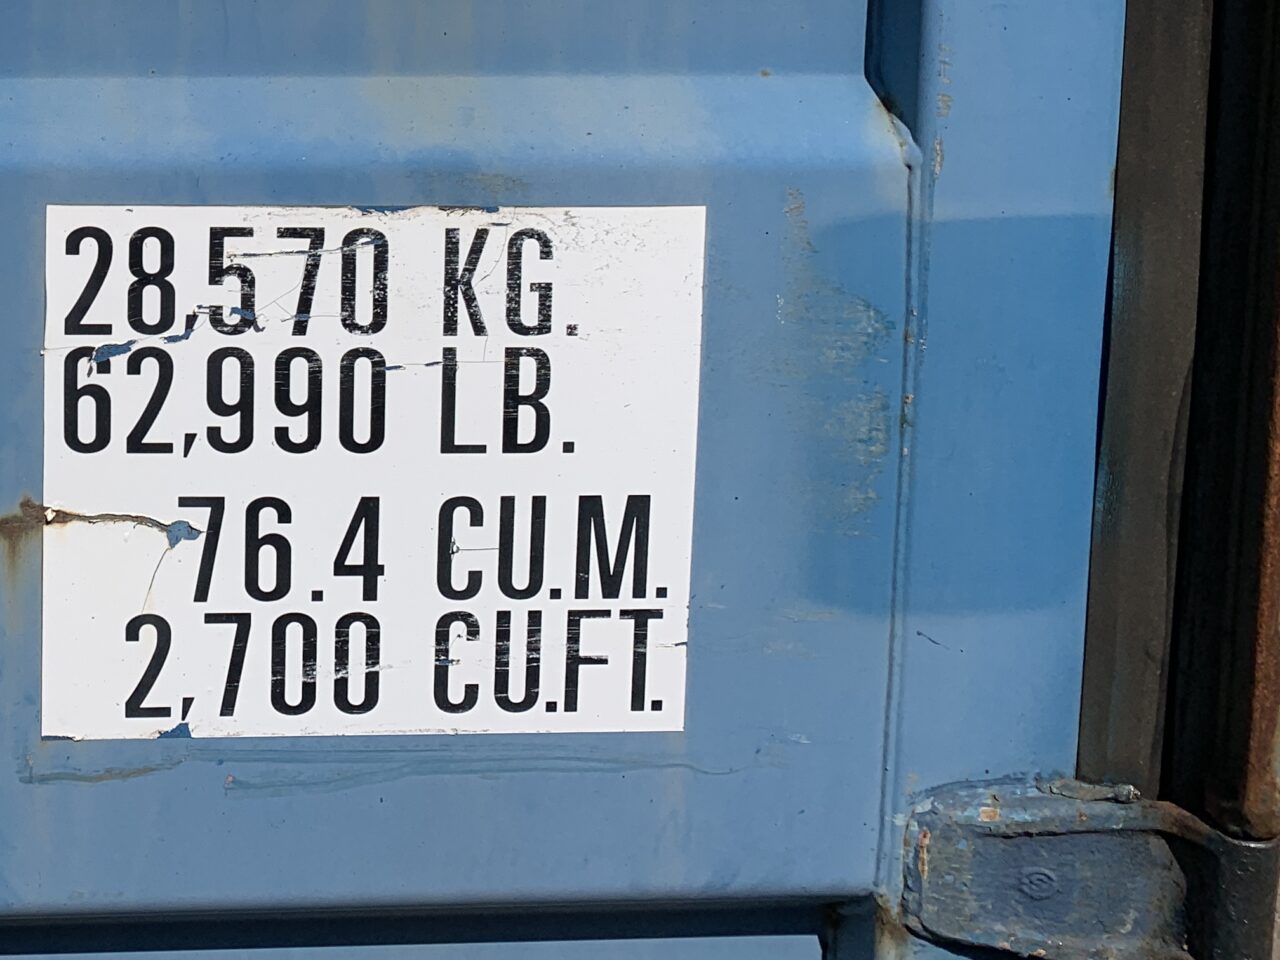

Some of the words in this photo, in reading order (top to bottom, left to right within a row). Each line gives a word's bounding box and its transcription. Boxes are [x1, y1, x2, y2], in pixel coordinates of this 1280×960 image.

[64, 226, 389, 342] 28,570
[442, 227, 579, 337] KG.
[63, 346, 387, 458] 62,990
[440, 346, 576, 455] LB.
[177, 495, 385, 602] 76.4
[436, 495, 668, 600] CU.M.
[124, 611, 381, 721] 2,700
[432, 608, 664, 713] CU.FT.
